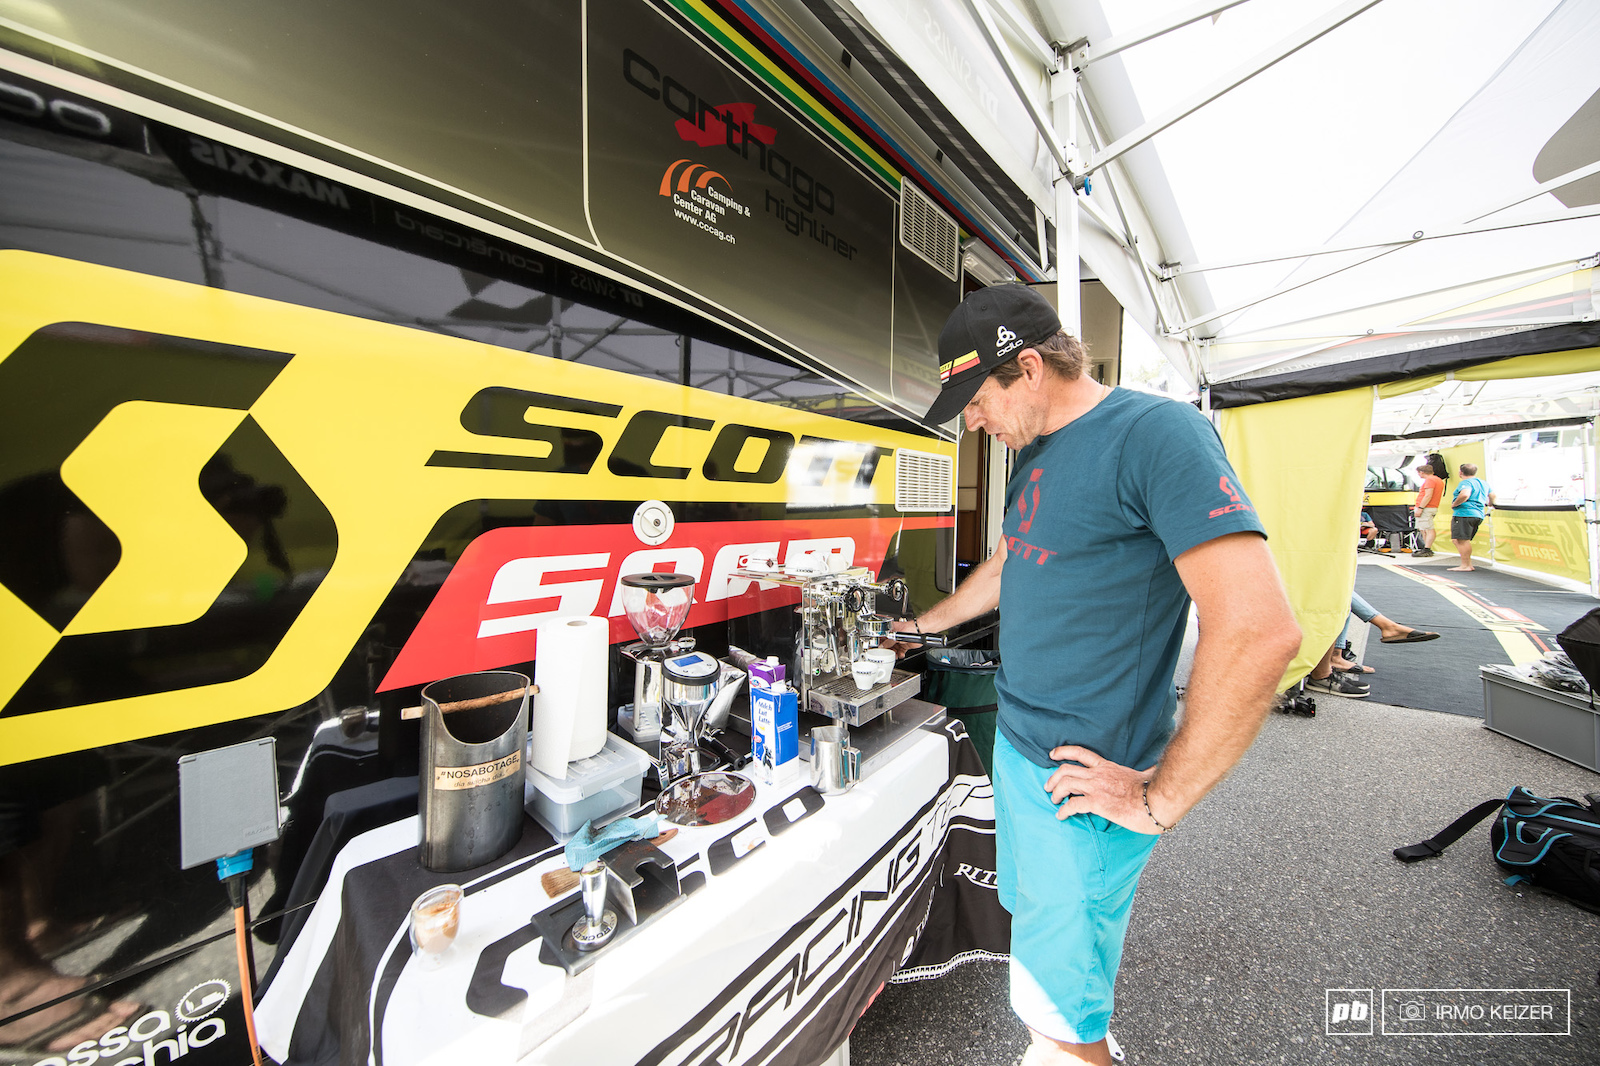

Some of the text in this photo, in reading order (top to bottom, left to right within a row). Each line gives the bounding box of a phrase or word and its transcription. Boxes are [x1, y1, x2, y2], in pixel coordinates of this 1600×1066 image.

[623, 48, 835, 216] carthago
[673, 193, 717, 223] Center AG
[691, 189, 725, 215] Caravan
[708, 186, 751, 218] Camping &
[673, 208, 736, 245] www.cccag.ch
[765, 189, 858, 261] highliner
[996, 339, 1024, 357] odlo
[424, 386, 894, 489] SCOTT
[476, 536, 857, 638] SRAM
[758, 701, 773, 712] Milch
[954, 863, 998, 888] RIT
